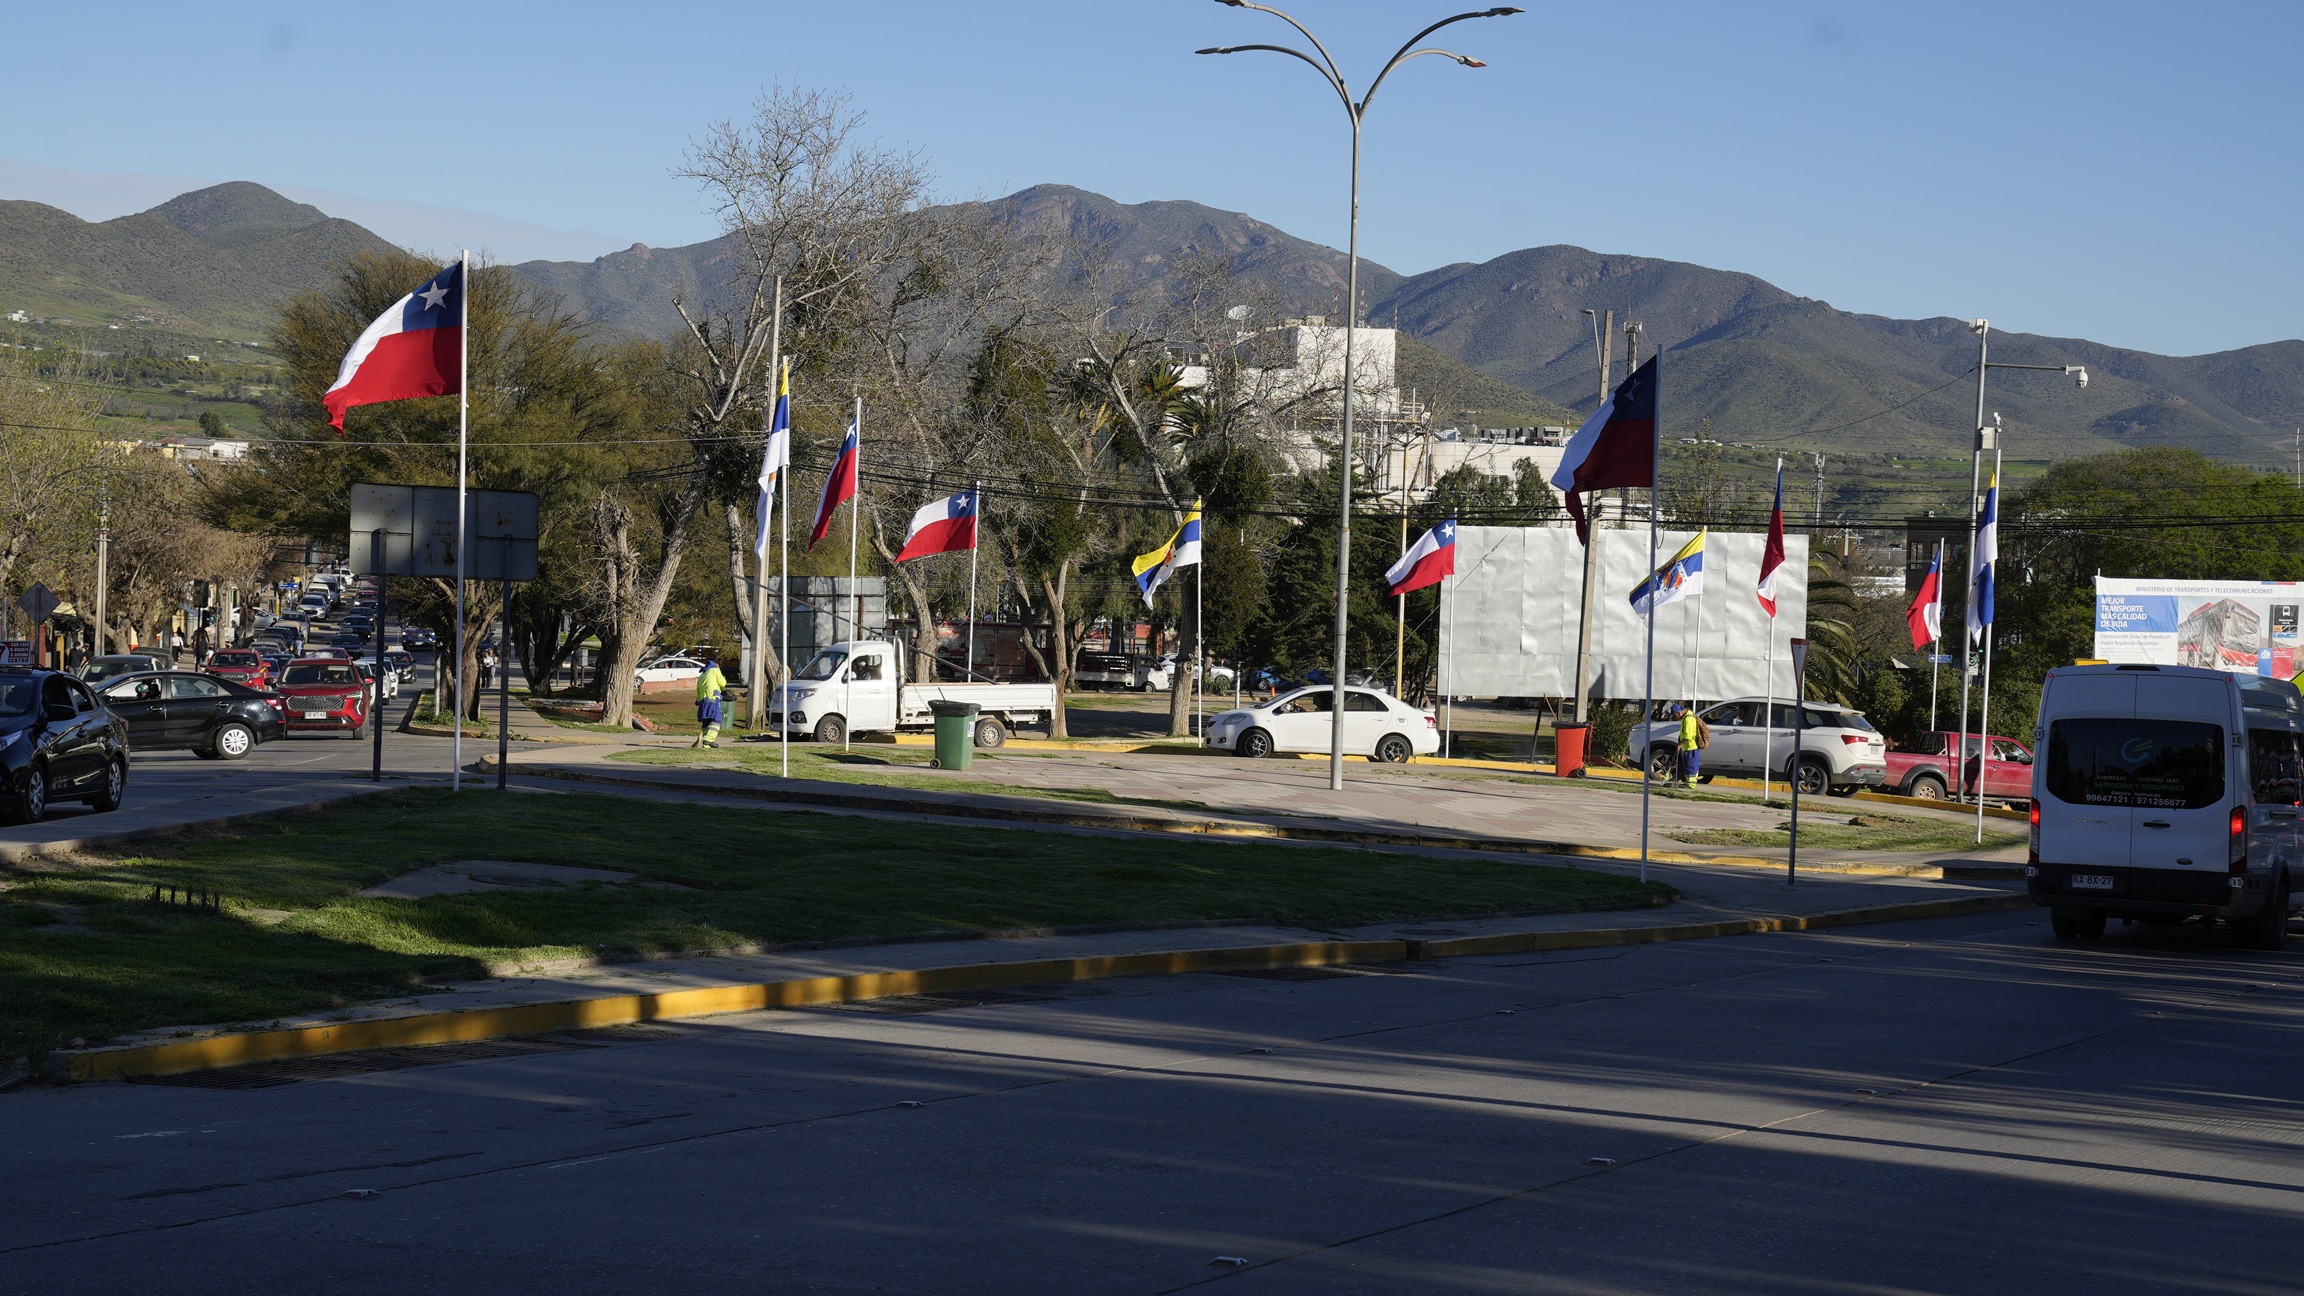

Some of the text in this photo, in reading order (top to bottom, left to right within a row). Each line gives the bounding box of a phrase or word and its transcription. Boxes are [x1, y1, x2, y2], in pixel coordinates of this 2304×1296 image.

[2101, 612, 2116, 620] MÁS
[2101, 620, 2128, 628] DE VIDA
[2094, 781, 2134, 789] SERVICIOS
[2141, 783, 2185, 791] SEGURIDAD
[2085, 793, 2128, 803] 99647121
[2136, 796, 2187, 807] 971256677
